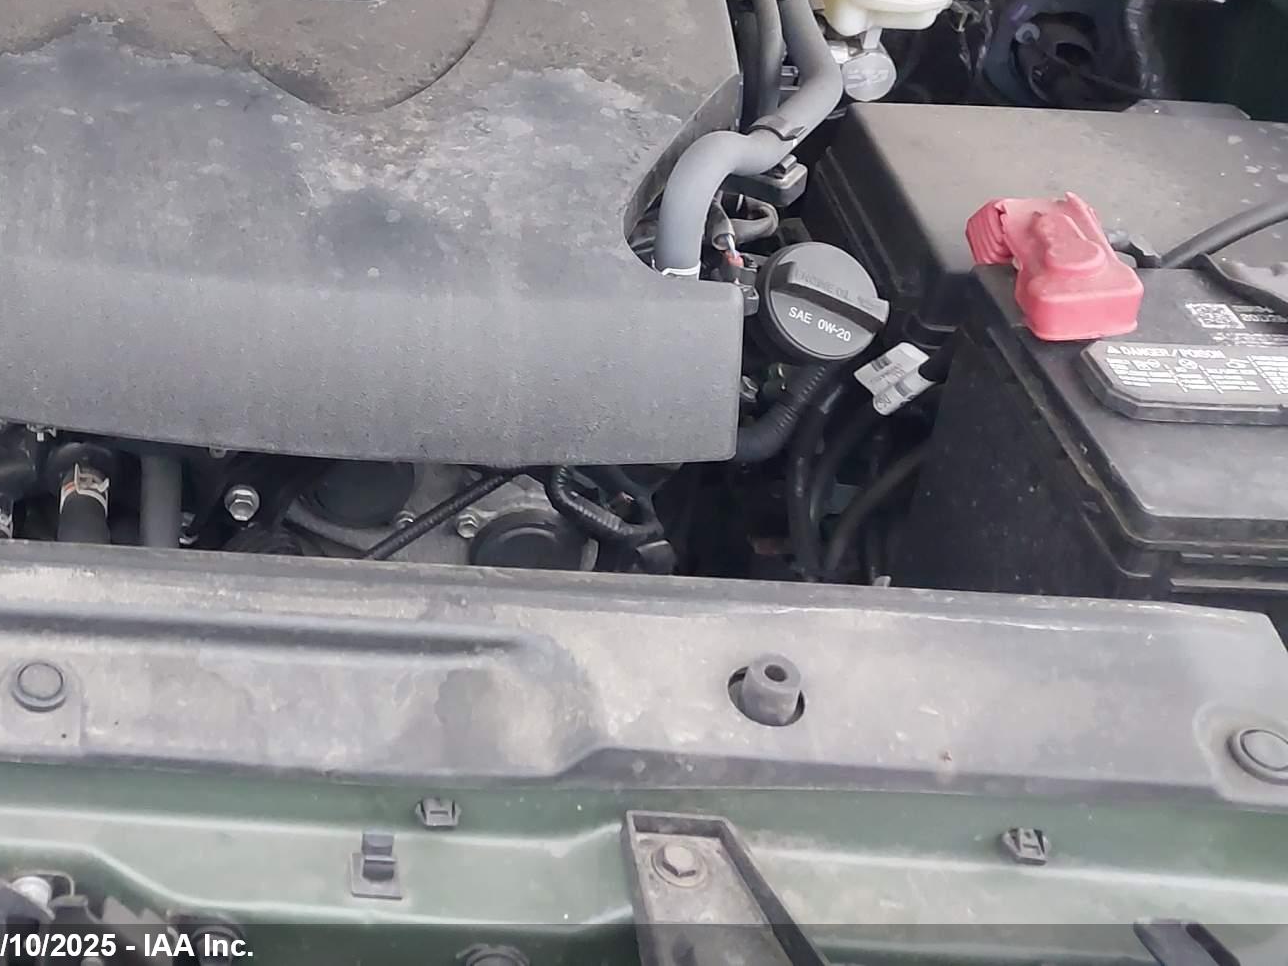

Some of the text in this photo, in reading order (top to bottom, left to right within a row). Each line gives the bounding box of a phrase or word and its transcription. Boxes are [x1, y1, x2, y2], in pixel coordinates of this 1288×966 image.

[788, 305, 852, 342] SAE 0W-20
[1120, 347, 1169, 358] DANGER
[1180, 348, 1226, 359] POISON
